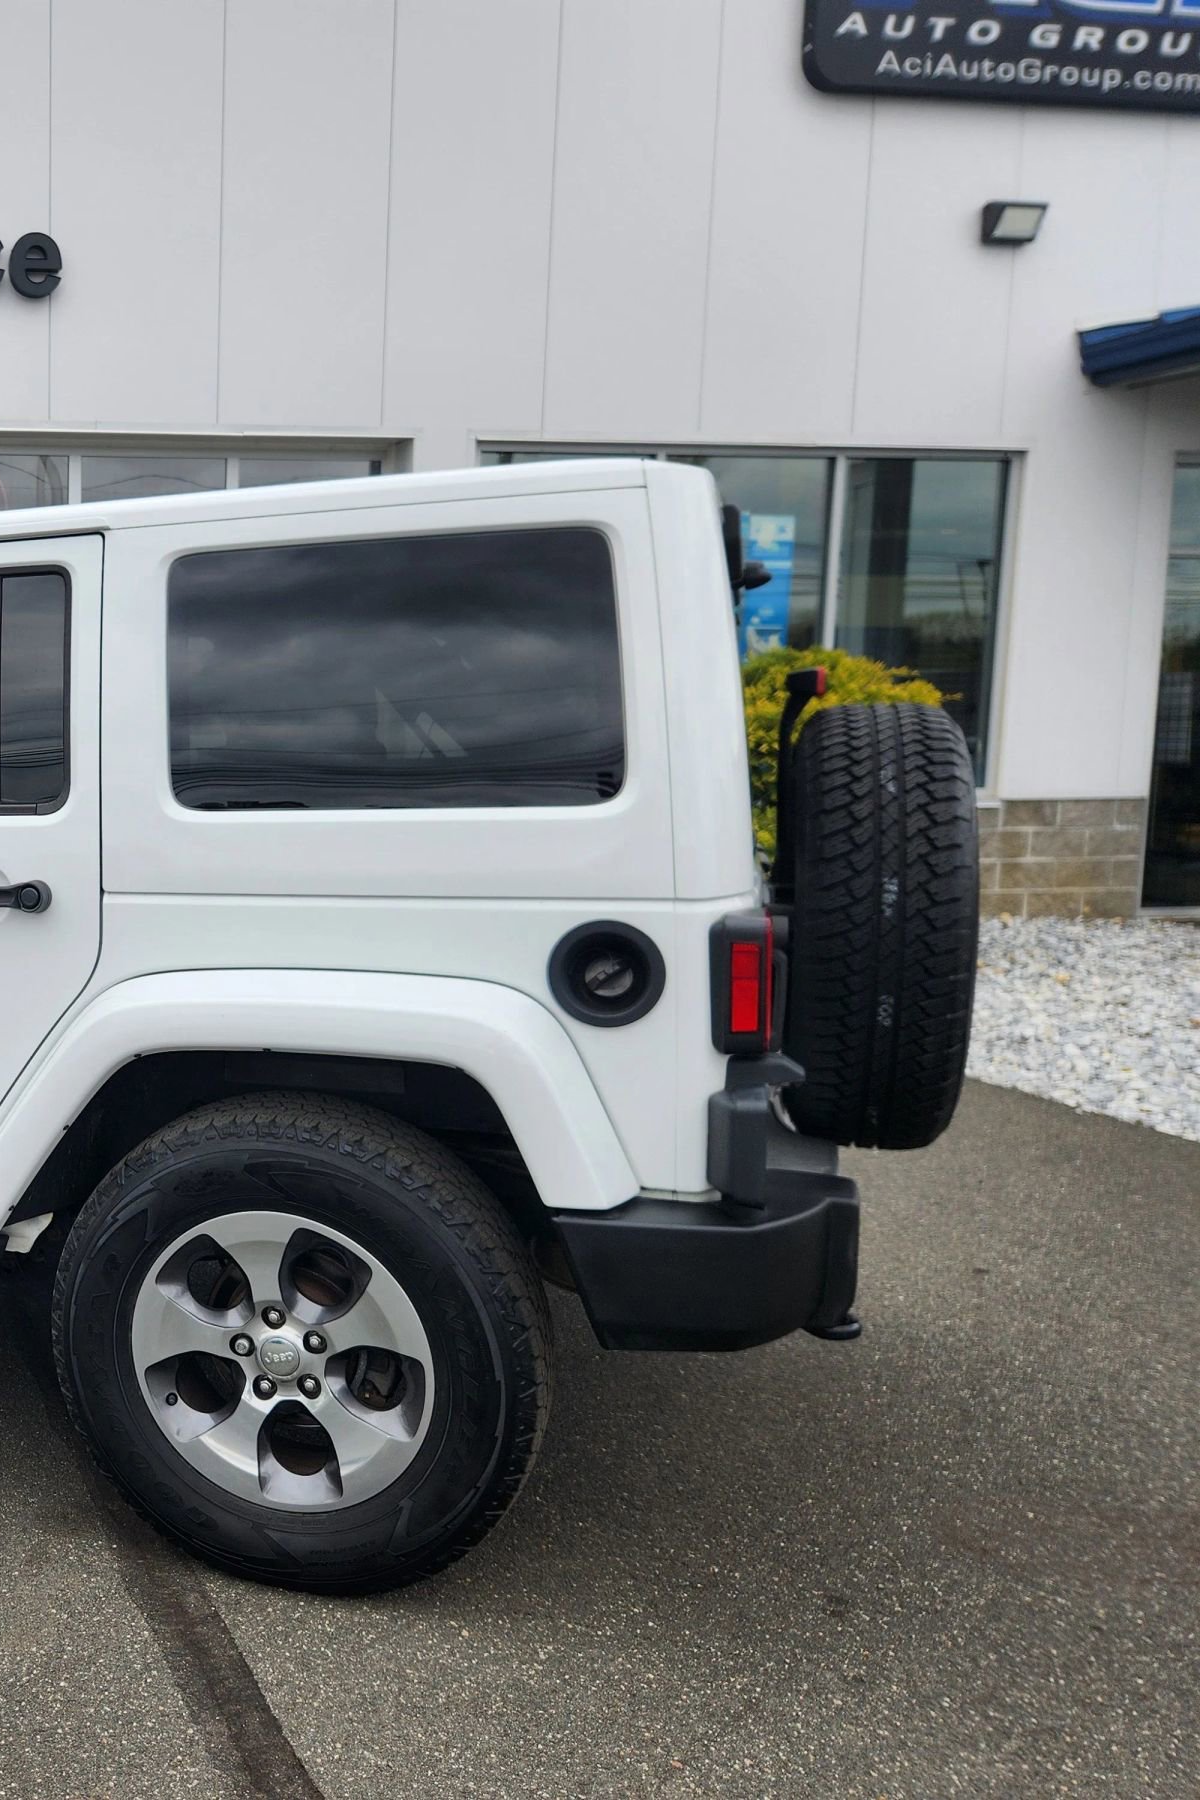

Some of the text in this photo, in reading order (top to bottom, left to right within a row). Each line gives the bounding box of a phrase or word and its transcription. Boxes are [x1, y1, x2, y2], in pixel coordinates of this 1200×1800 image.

[834, 11, 1200, 58] AUTO GROU
[875, 50, 1200, 95] AciAutoGroup.com
[264, 1351, 294, 1363] Jeep
